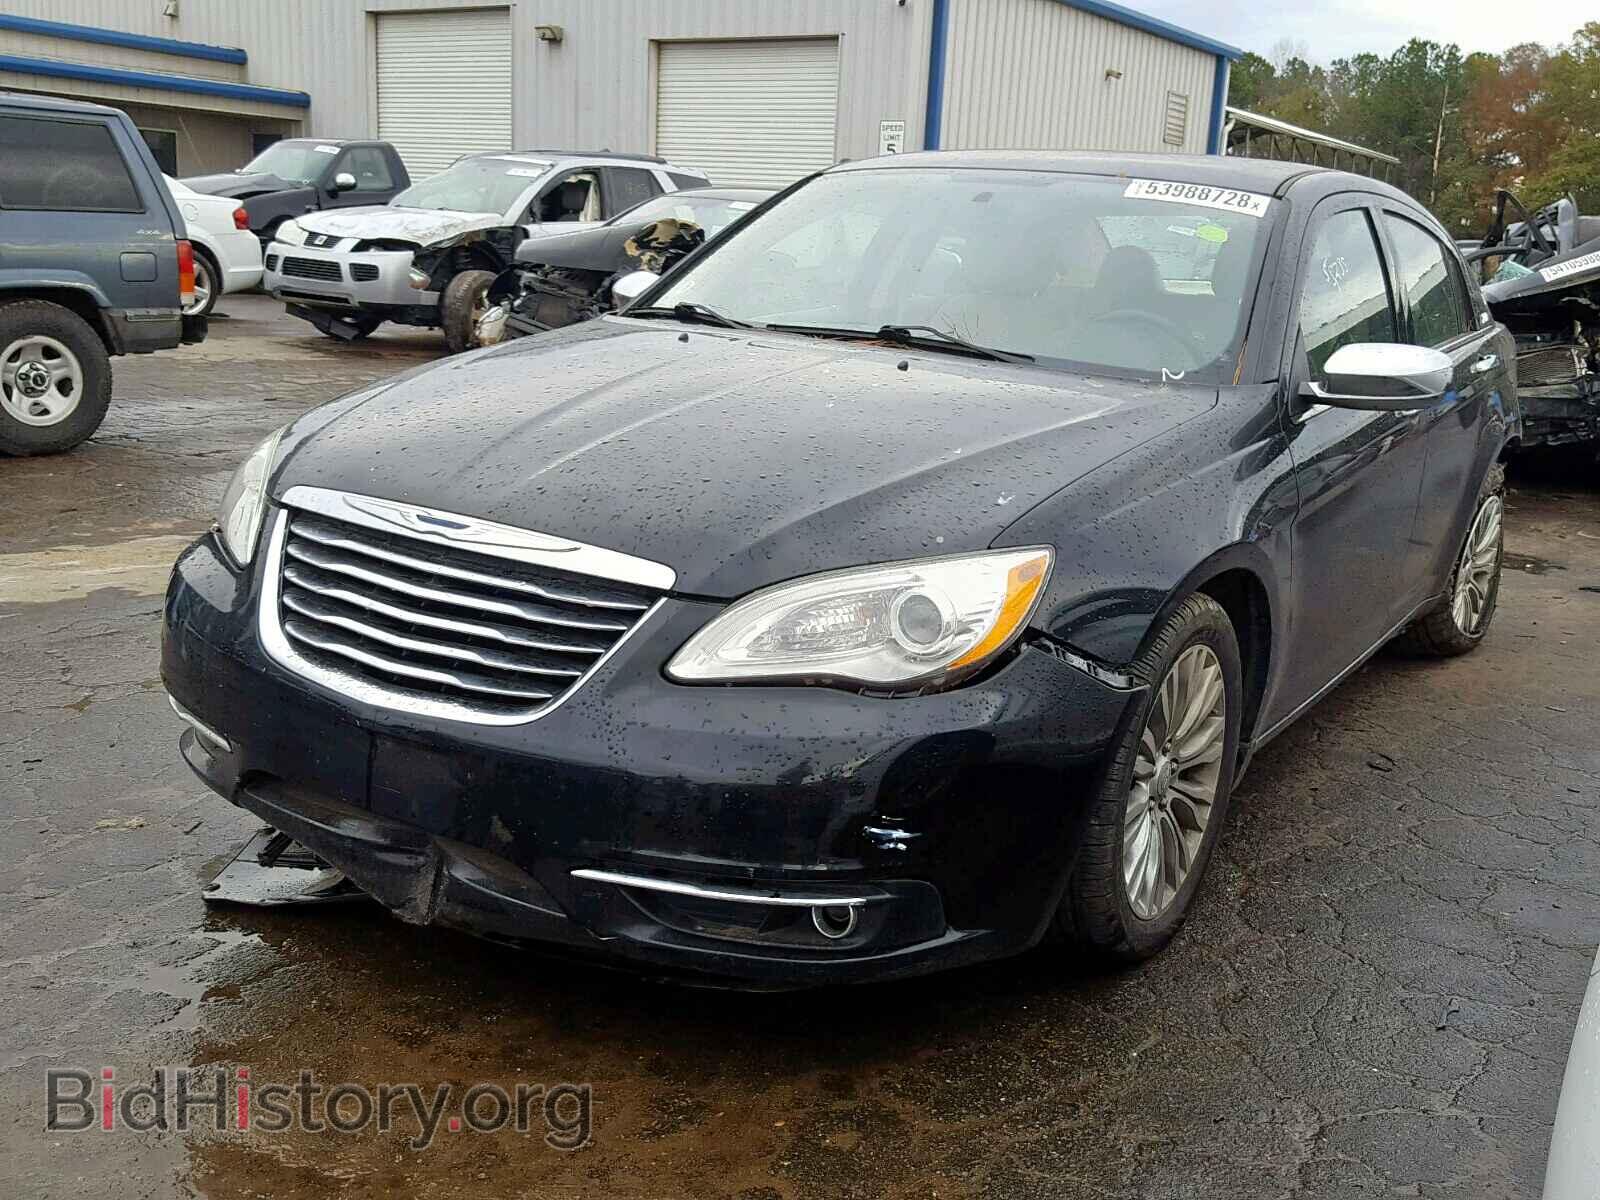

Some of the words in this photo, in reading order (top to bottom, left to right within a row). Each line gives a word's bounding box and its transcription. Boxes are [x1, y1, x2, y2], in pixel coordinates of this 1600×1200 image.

[881, 124, 904, 132] SPEED
[886, 143, 897, 154] 5
[1144, 181, 1251, 209] 53988728
